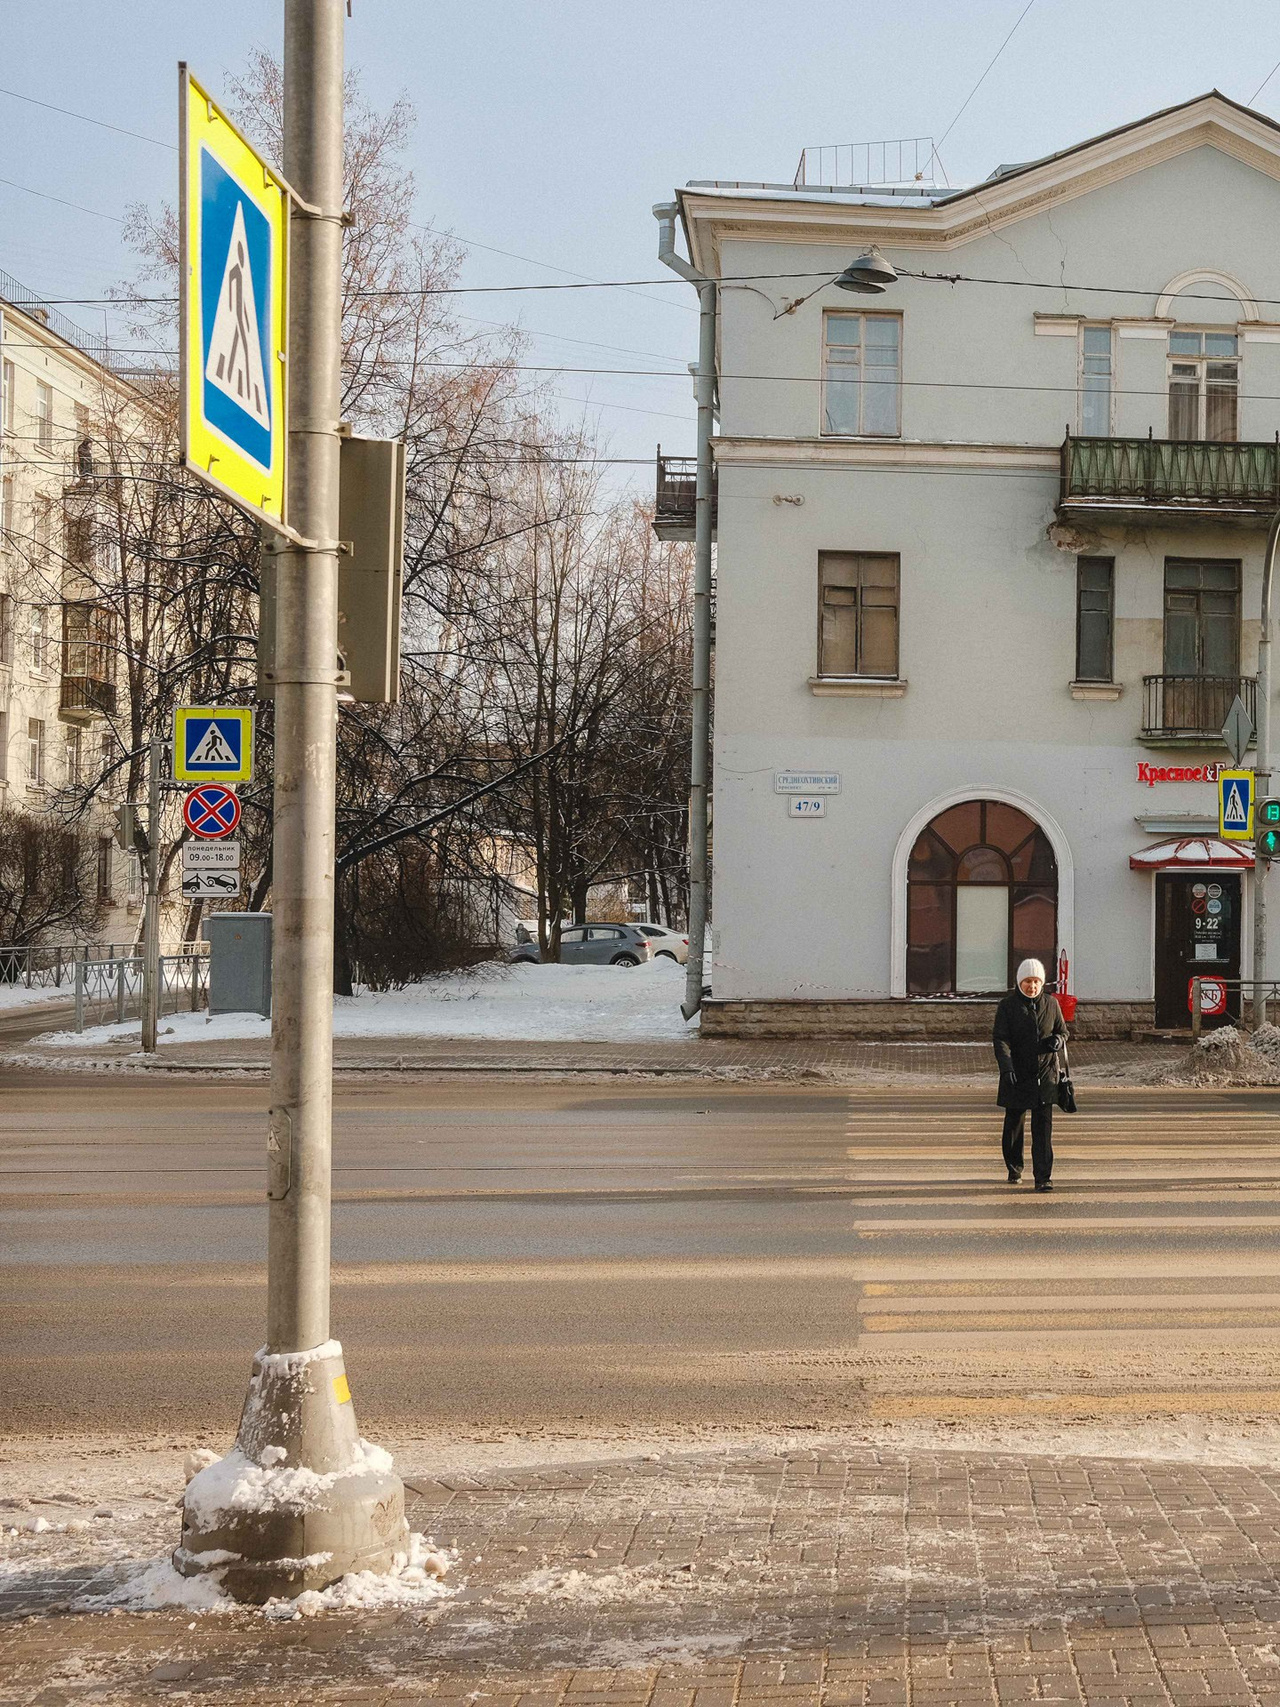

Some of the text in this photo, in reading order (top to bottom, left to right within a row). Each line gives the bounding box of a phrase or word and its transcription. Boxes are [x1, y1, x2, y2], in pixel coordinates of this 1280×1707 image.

[778, 775, 837, 785] СРЕДНЕОХТИНСКИЙ
[795, 801, 820, 811] 47/9
[1267, 805, 1280, 820] 13
[189, 853, 234, 861] 09.00-18.00
